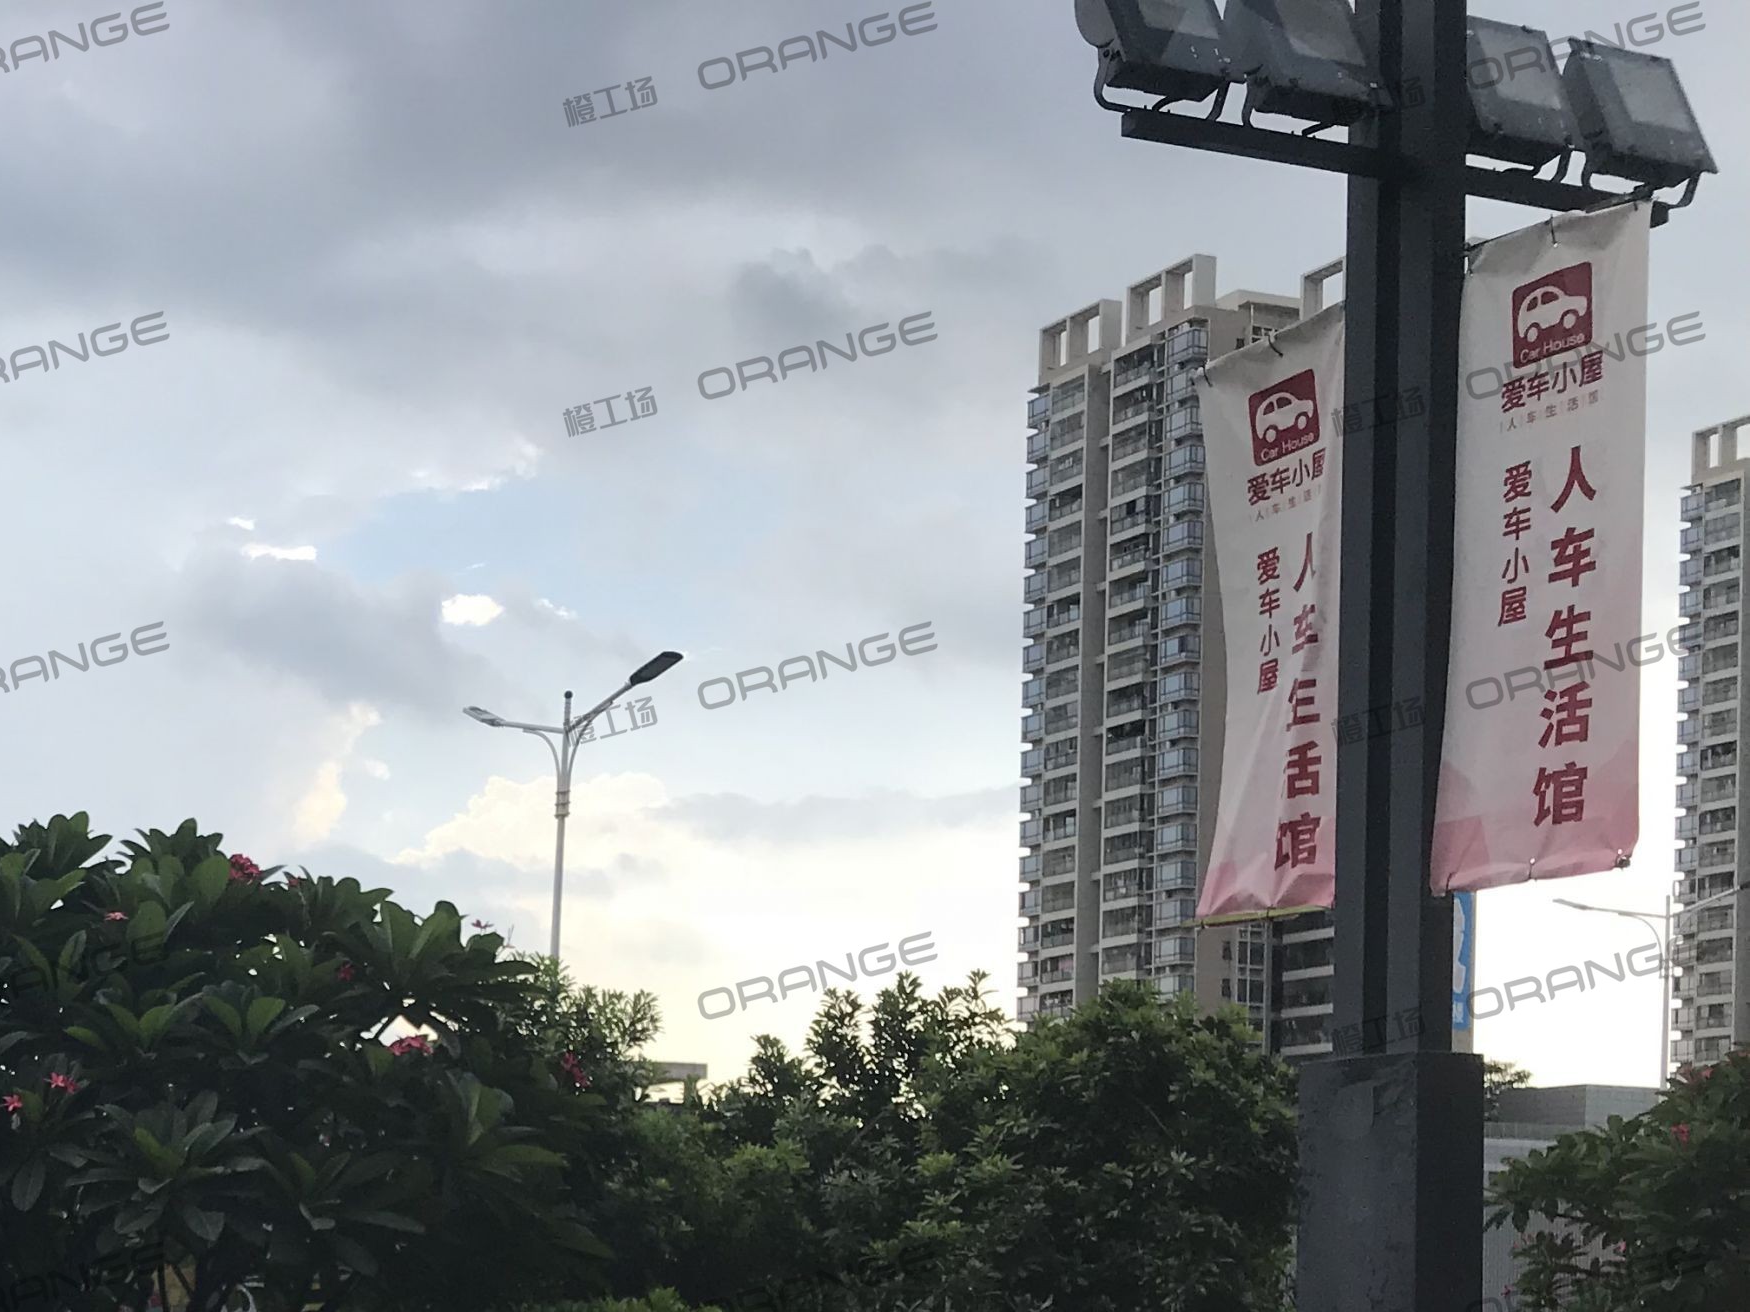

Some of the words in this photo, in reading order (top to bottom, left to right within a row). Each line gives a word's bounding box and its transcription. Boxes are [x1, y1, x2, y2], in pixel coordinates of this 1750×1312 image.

[1520, 347, 1541, 363] Car
[1543, 333, 1586, 355] House
[1501, 350, 1603, 413] 爱车小屋
[1247, 447, 1326, 506] 爱车小屋
[1260, 447, 1279, 462] Car
[1282, 432, 1315, 455] House
[1497, 460, 1532, 627] 爱车小屋
[1256, 546, 1280, 695] 爱车小屋
[1533, 445, 1597, 828] 人车生活馆
